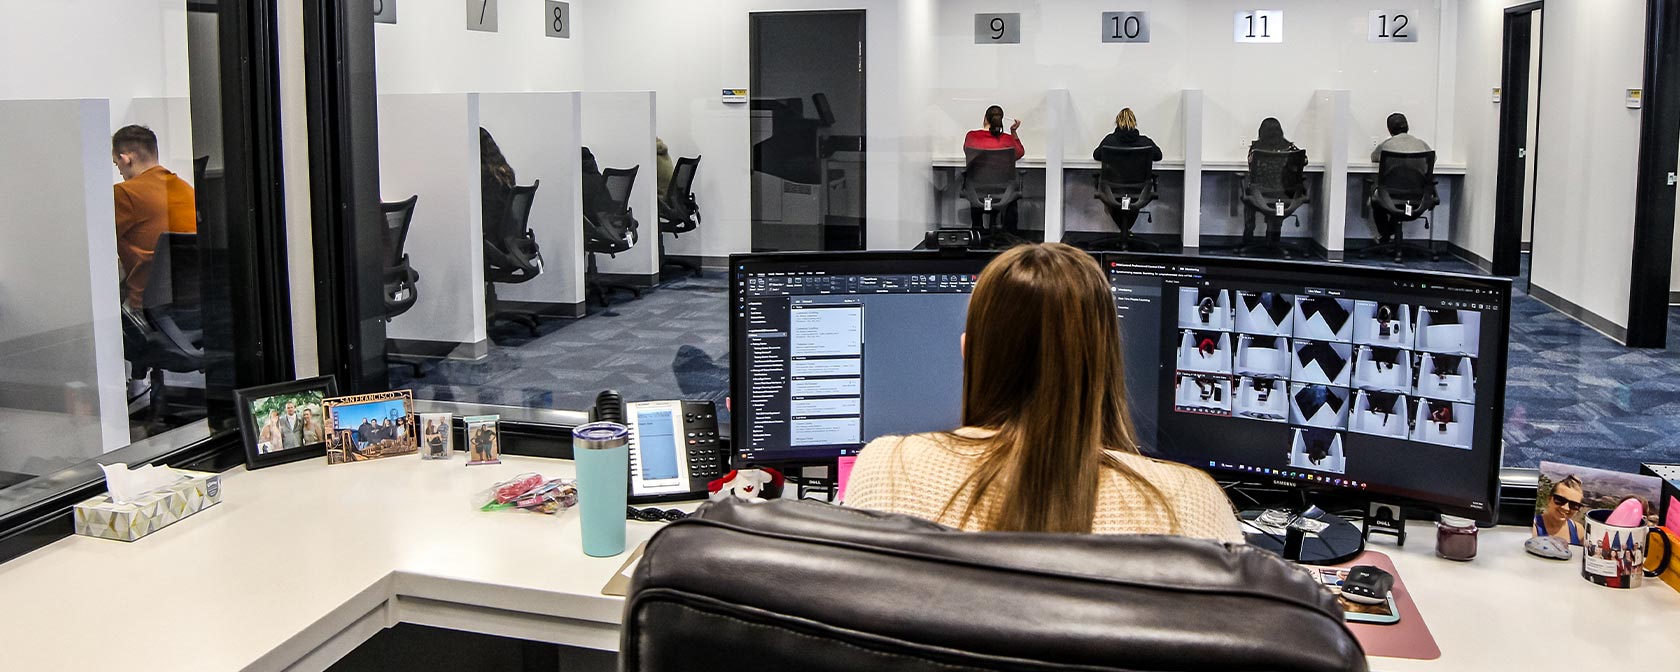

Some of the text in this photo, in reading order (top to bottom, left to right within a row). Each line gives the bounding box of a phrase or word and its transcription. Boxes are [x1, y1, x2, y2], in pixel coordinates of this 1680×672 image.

[553, 6, 563, 32] 8
[990, 17, 1005, 40] 9
[1111, 16, 1140, 39] 10
[1244, 15, 1271, 38] 11
[1378, 14, 1409, 38] 12
[356, 392, 395, 402] FRANCISCO
